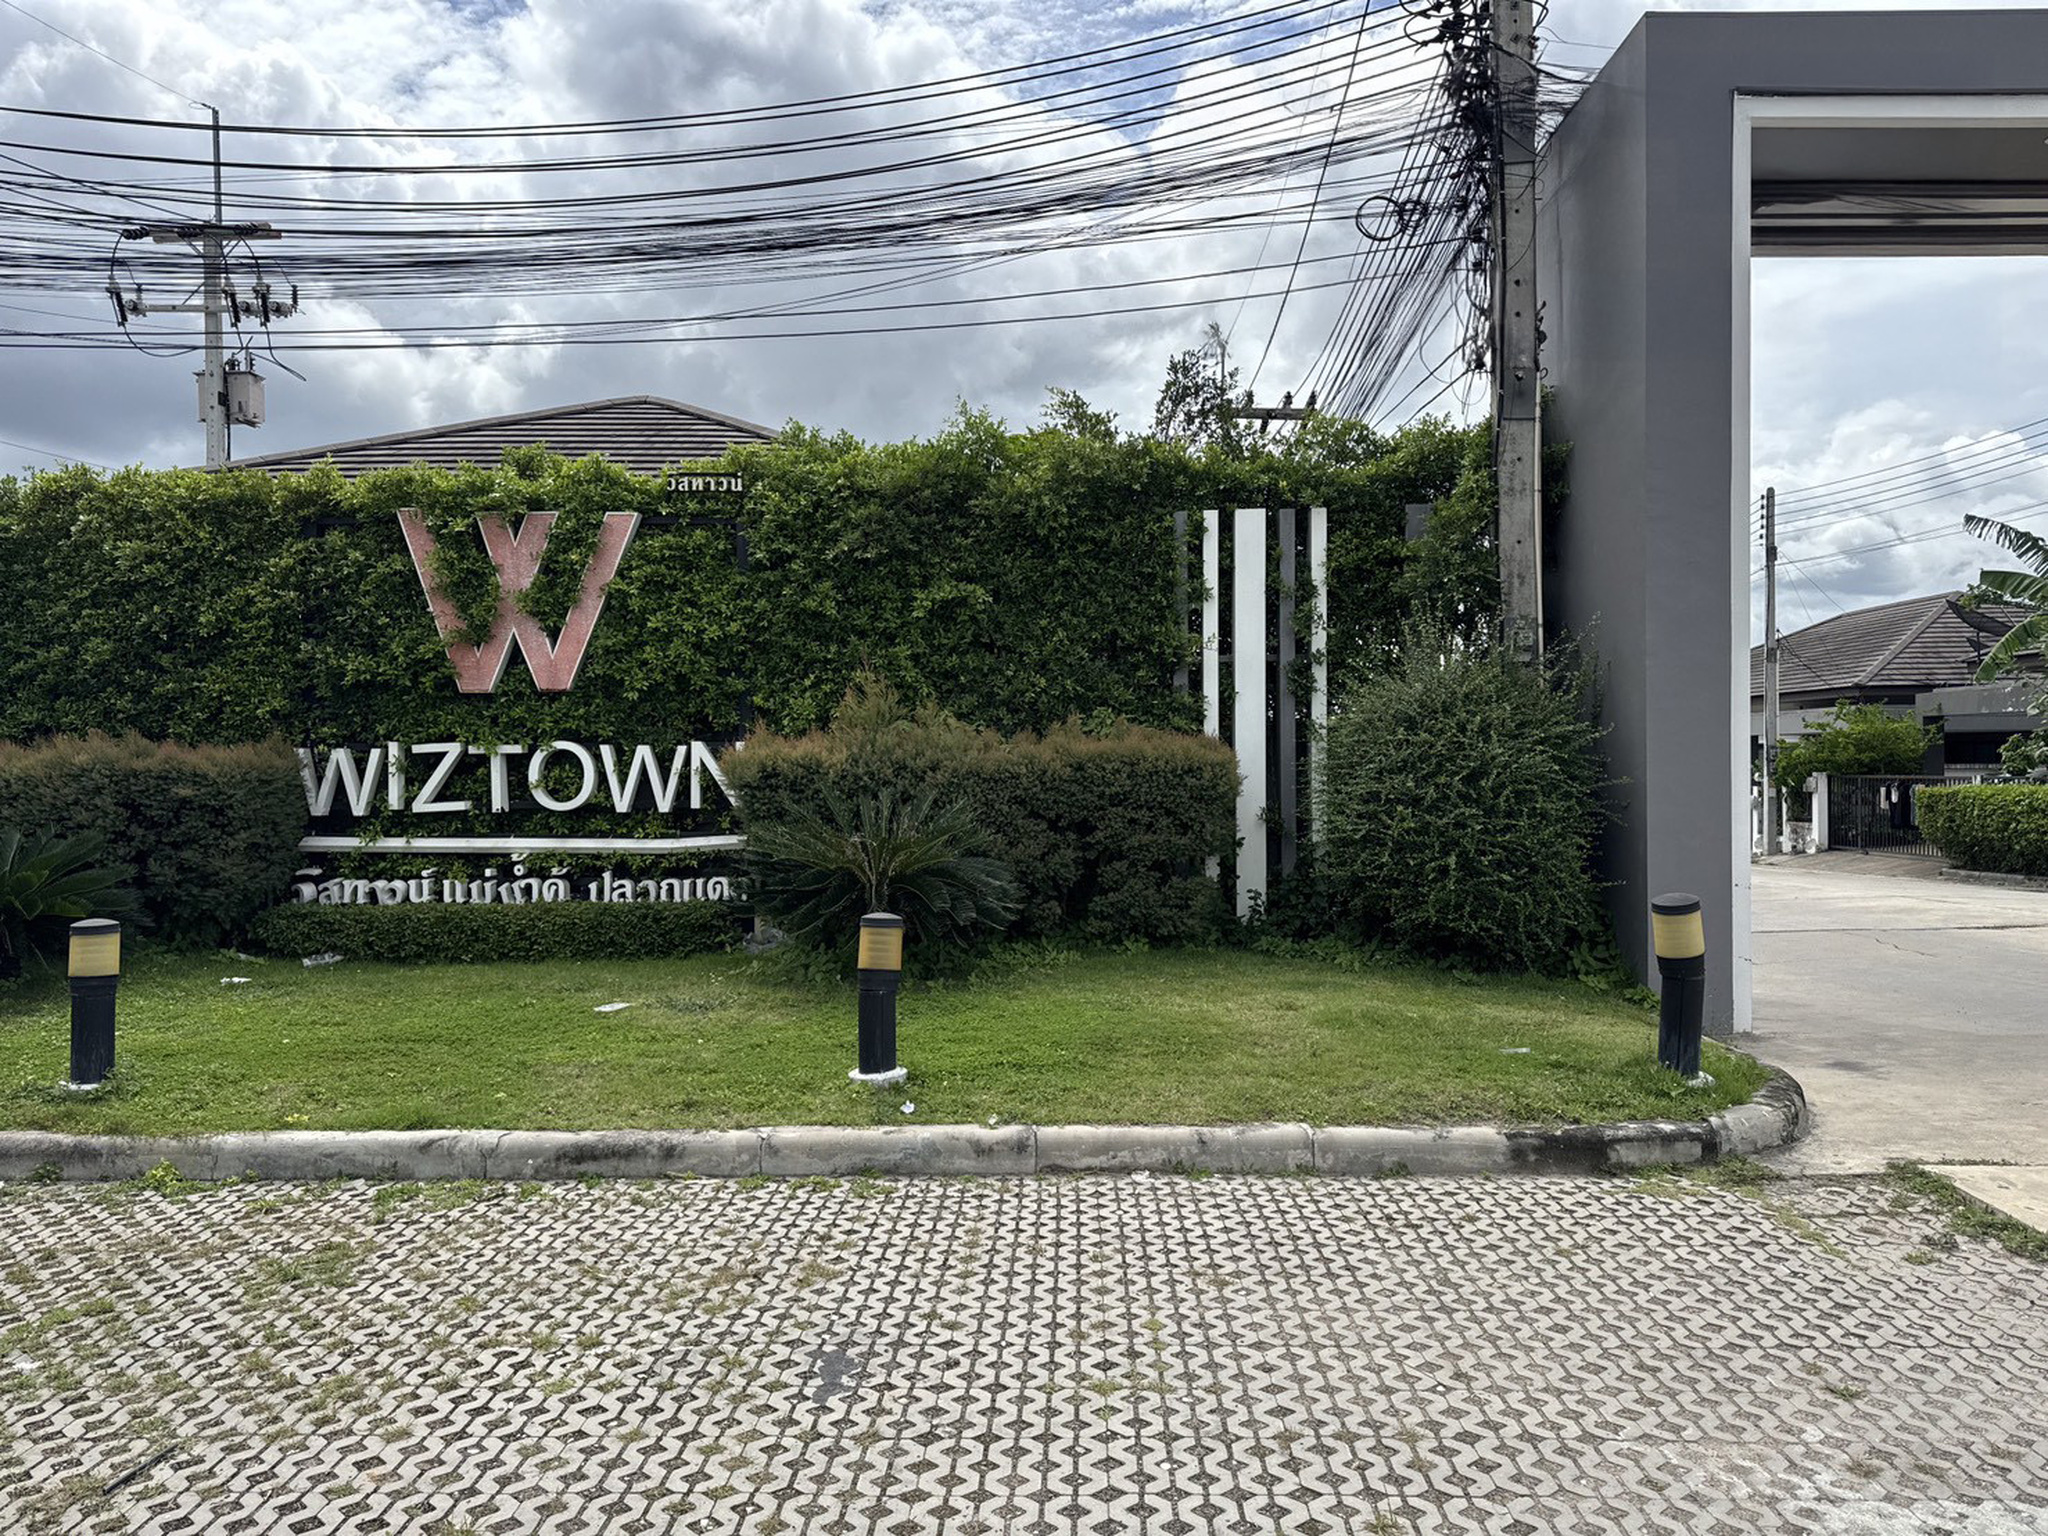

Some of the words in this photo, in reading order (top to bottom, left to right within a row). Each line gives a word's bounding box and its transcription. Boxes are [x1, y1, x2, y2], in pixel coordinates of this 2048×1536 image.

[397, 507, 642, 694] W
[293, 740, 746, 817] WIZTOWN
[588, 870, 748, 903] ปลวกแด
